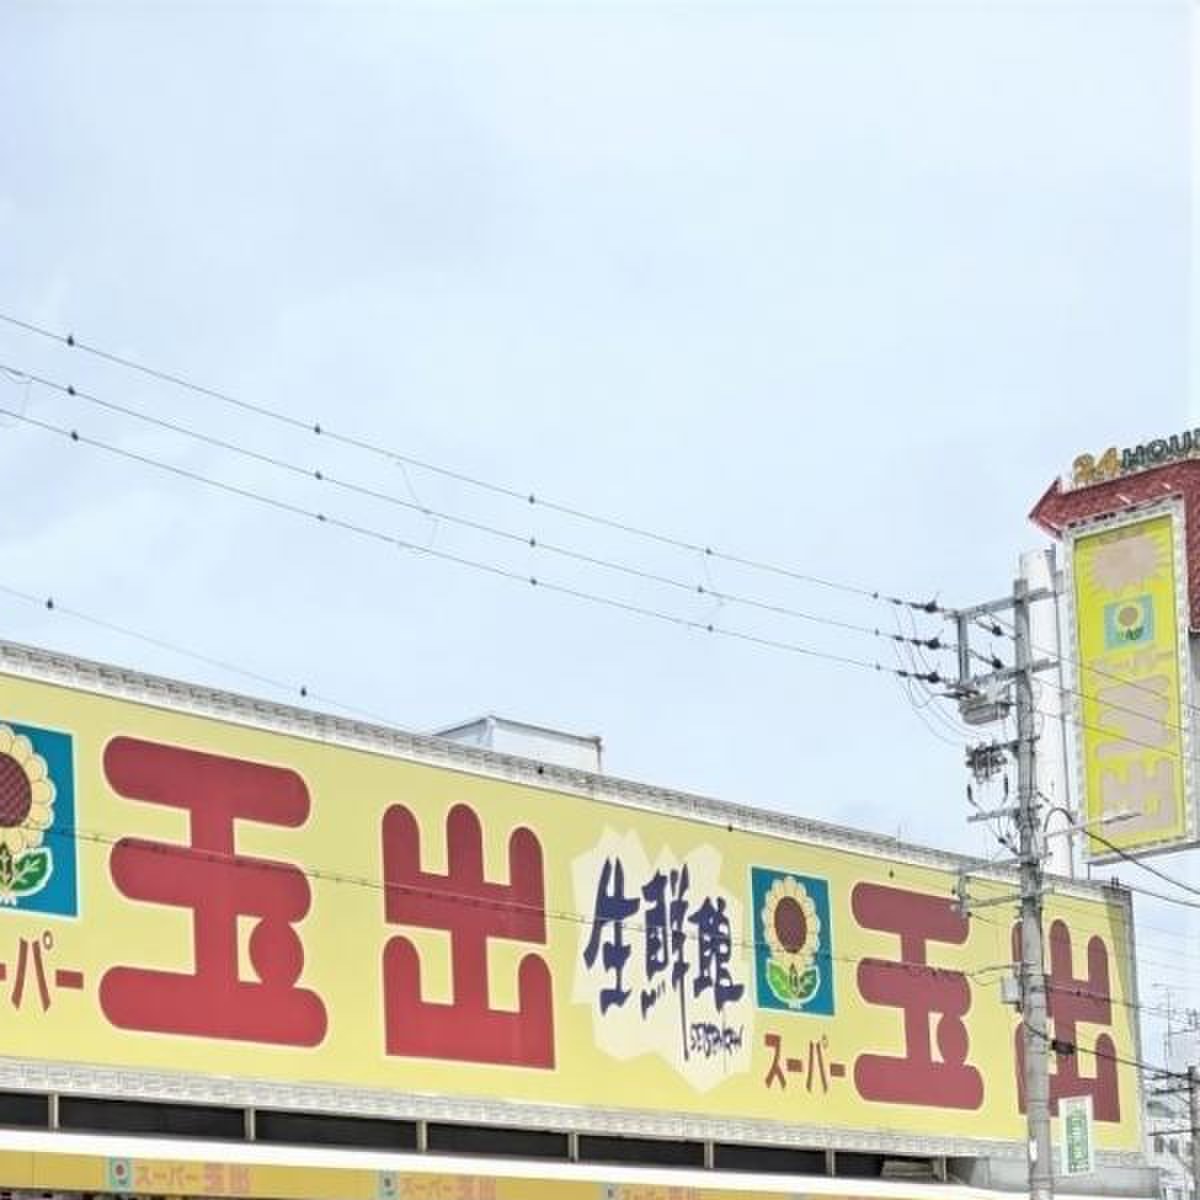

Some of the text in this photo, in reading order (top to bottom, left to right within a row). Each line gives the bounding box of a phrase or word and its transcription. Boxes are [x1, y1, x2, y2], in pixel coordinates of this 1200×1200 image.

[99, 735, 556, 1071] 玉出
[764, 1033, 846, 1094] スーパー
